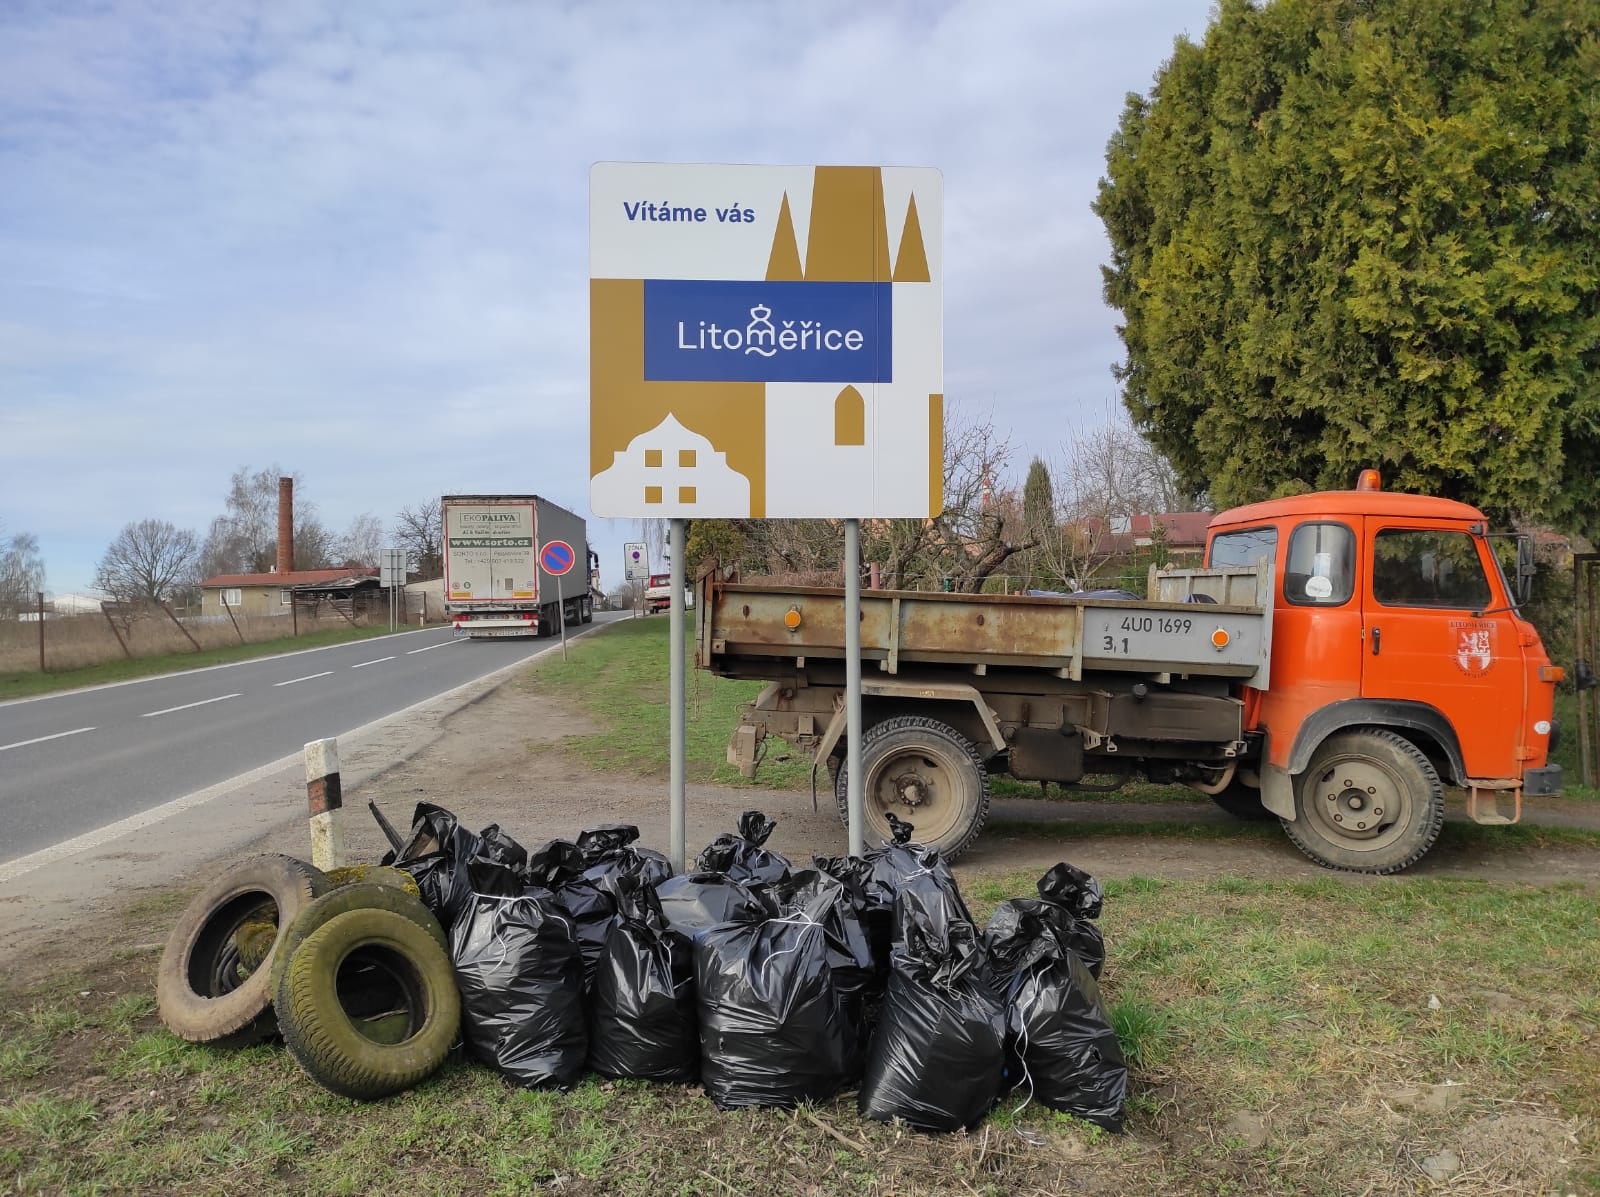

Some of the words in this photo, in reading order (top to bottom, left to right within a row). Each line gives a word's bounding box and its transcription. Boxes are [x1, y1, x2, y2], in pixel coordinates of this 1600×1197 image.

[623, 200, 707, 222] Vítáme
[715, 202, 755, 223] vás
[678, 304, 864, 356] Litoměřice
[463, 514, 516, 522] EKOPALIVA
[1158, 618, 1192, 634] 1699
